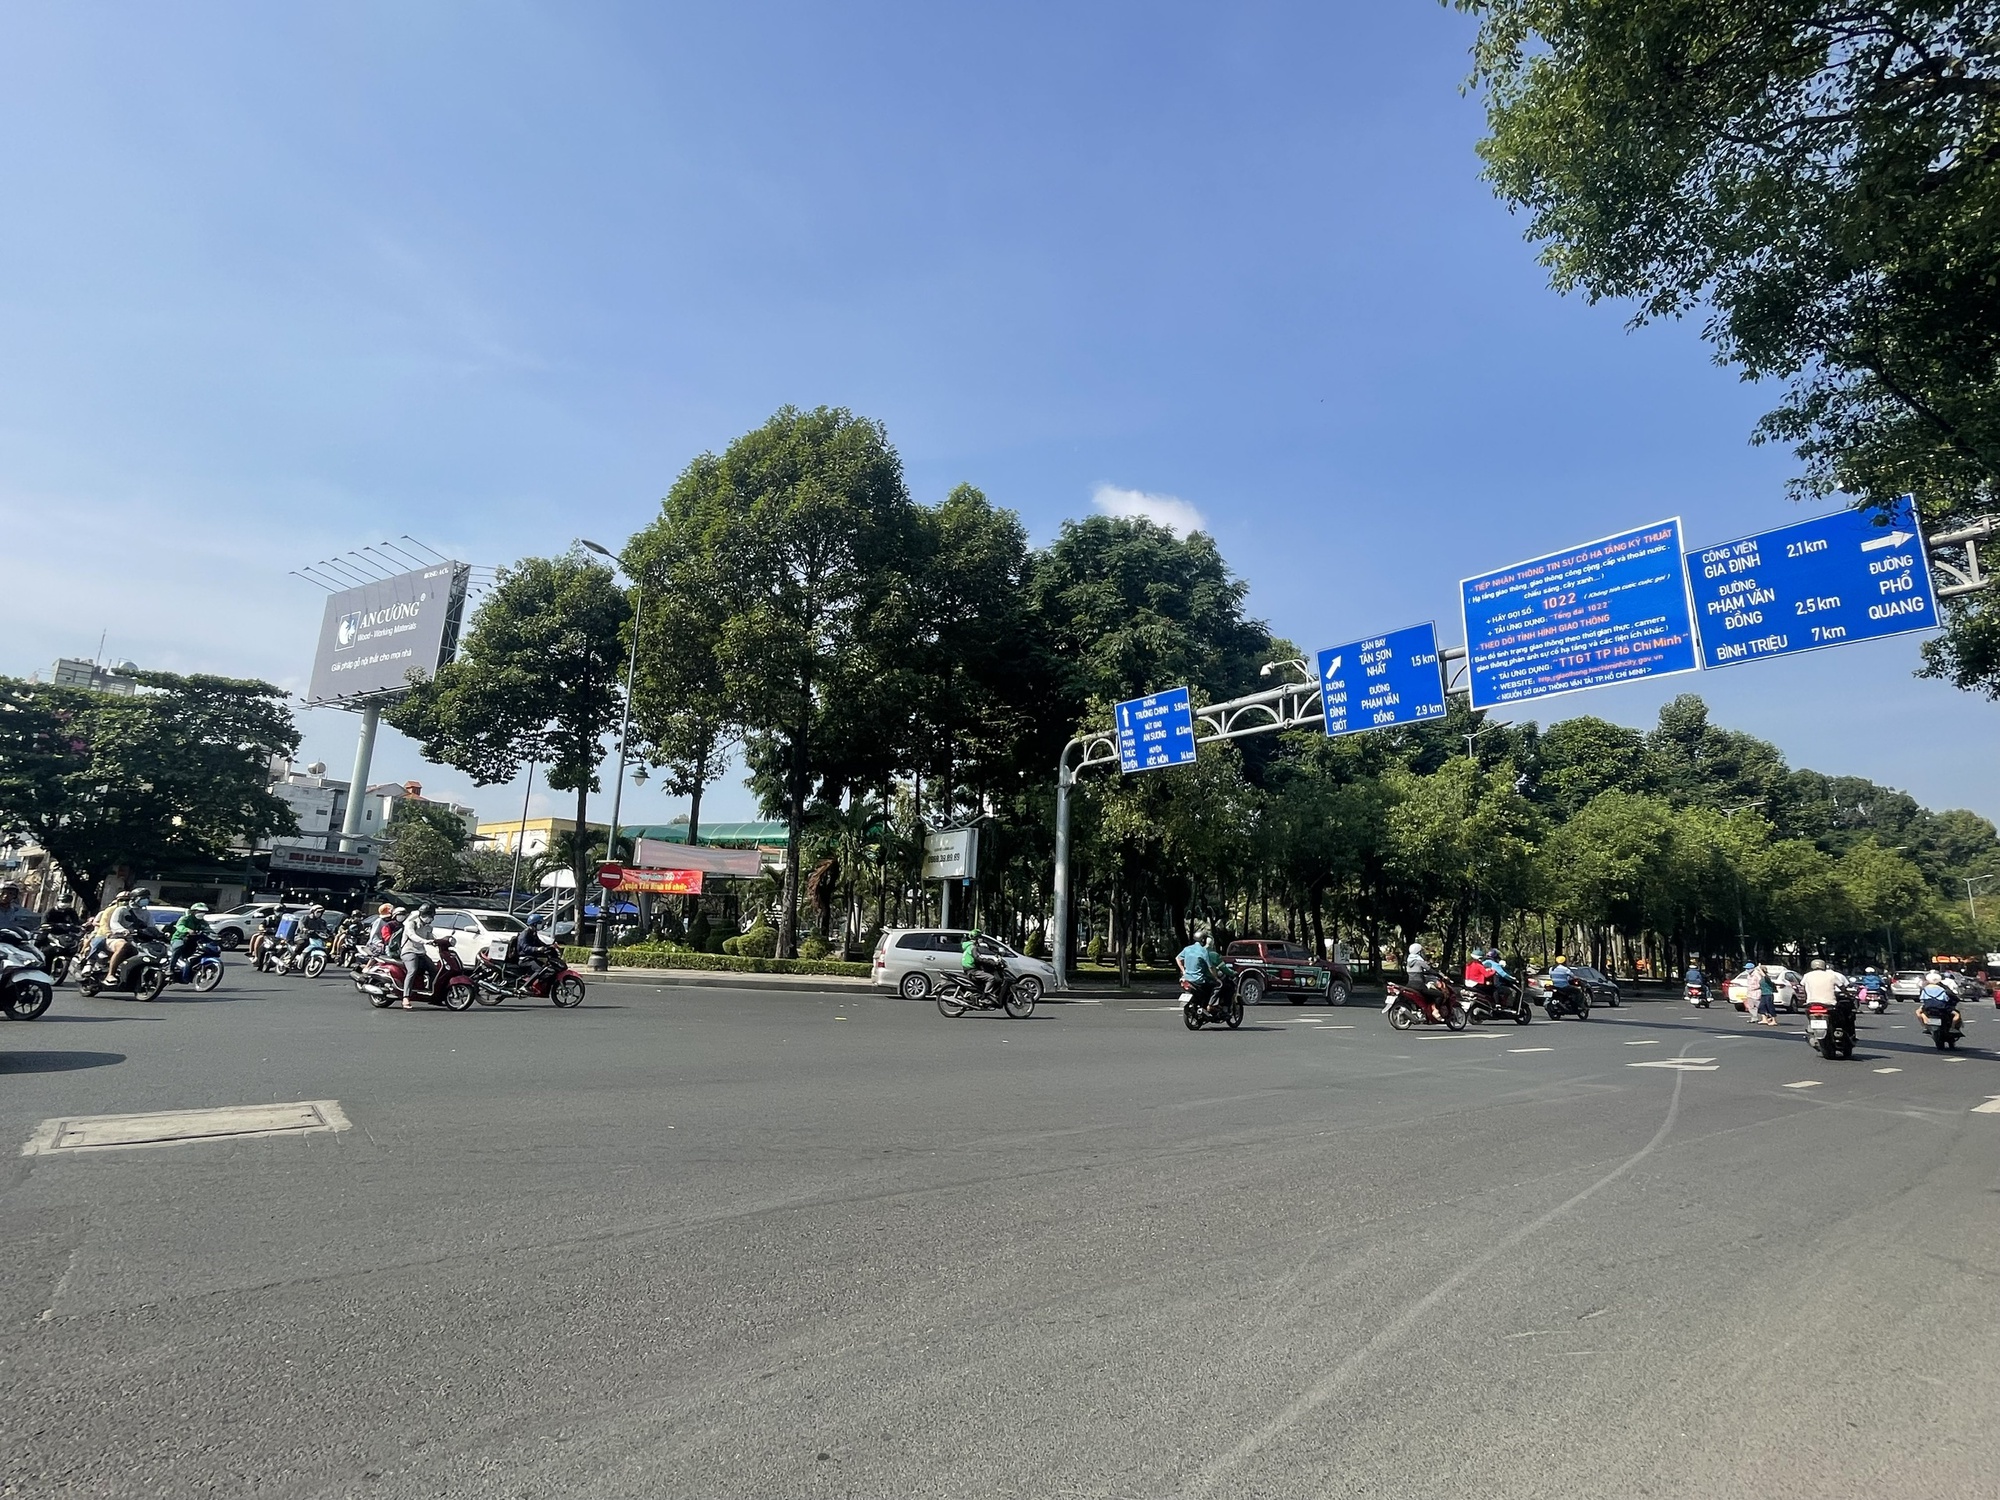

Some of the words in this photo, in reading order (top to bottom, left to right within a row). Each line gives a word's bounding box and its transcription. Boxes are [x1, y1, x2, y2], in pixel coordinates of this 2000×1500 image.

[1702, 548, 1731, 564] CÔNG
[1732, 540, 1758, 556] VIÊN
[1804, 539, 1828, 554] km
[1546, 561, 1560, 572] TIN
[1704, 562, 1727, 578] GIA
[1728, 553, 1761, 574] ĐỊNH
[1869, 554, 1913, 574] ĐƯỜNG
[1719, 578, 1756, 596] ĐƯỜNG
[1879, 570, 1913, 596] PHỔ
[1543, 592, 1576, 610] 1022
[1707, 594, 1745, 616] PHẠM
[1746, 588, 1776, 606] VĂN
[1817, 596, 1841, 610] km
[1868, 596, 1925, 620] QUANG
[1634, 616, 1666, 627] camera
[1724, 610, 1763, 630] ĐỒNG
[1375, 638, 1386, 648] BAY
[1480, 640, 1500, 650] THEO
[1559, 622, 1578, 632] GIAO
[1811, 627, 1820, 642] 7
[1822, 626, 1846, 640] km
[1595, 648, 1611, 660] TP
[1716, 642, 1748, 660] BÌNH
[1748, 634, 1788, 654] TRIỆU
[1359, 652, 1374, 666] TÂN
[1376, 648, 1392, 661] SƠN
[1422, 653, 1436, 664] km
[1366, 660, 1386, 677] NHẤT
[1327, 692, 1347, 705] PHAN
[1361, 696, 1383, 710] PHẠM
[1384, 692, 1400, 706] VĂN
[1430, 703, 1443, 714] km
